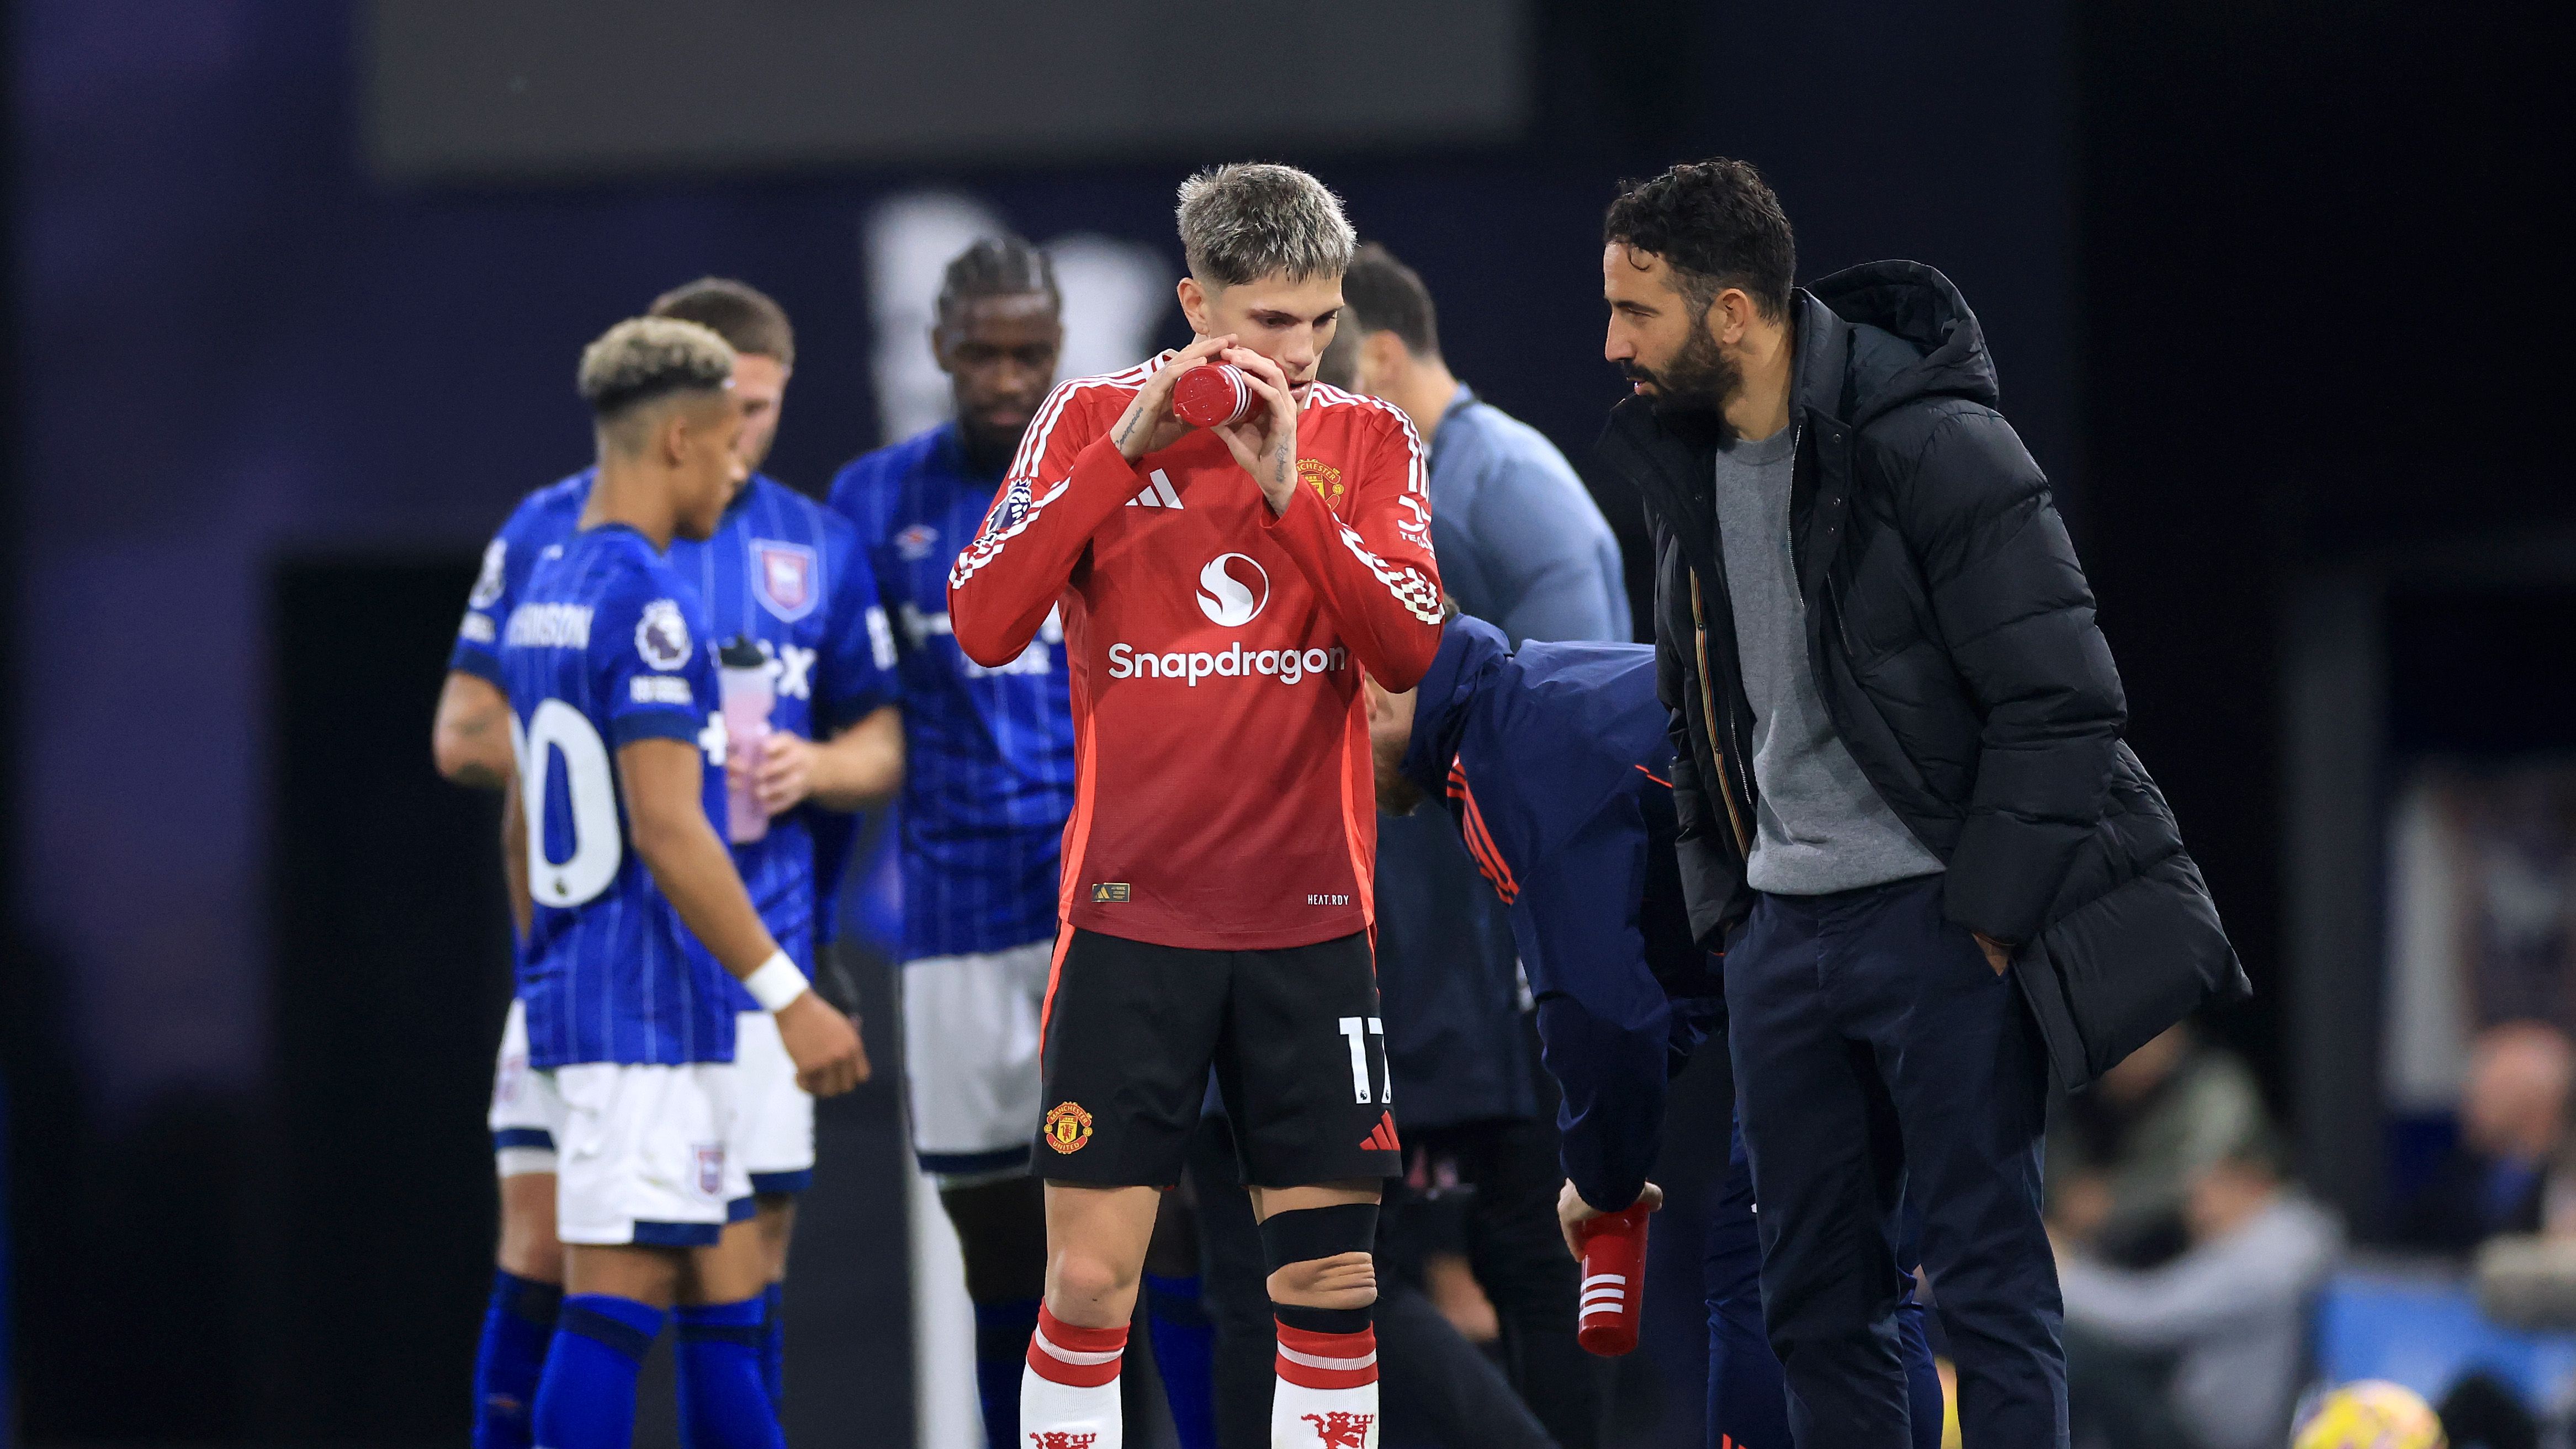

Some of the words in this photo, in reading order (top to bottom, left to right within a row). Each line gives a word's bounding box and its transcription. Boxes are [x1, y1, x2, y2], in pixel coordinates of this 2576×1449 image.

[1296, 463, 1337, 481] CHESTER
[1108, 641, 1345, 687] Snapdragon
[510, 698, 622, 909] 0
[1307, 894, 1349, 905] HEAT.RDY
[1338, 1016, 1391, 1105] 17
[1050, 1105, 1089, 1124] MANCHESTER
[1052, 1140, 1080, 1151] UNITED
